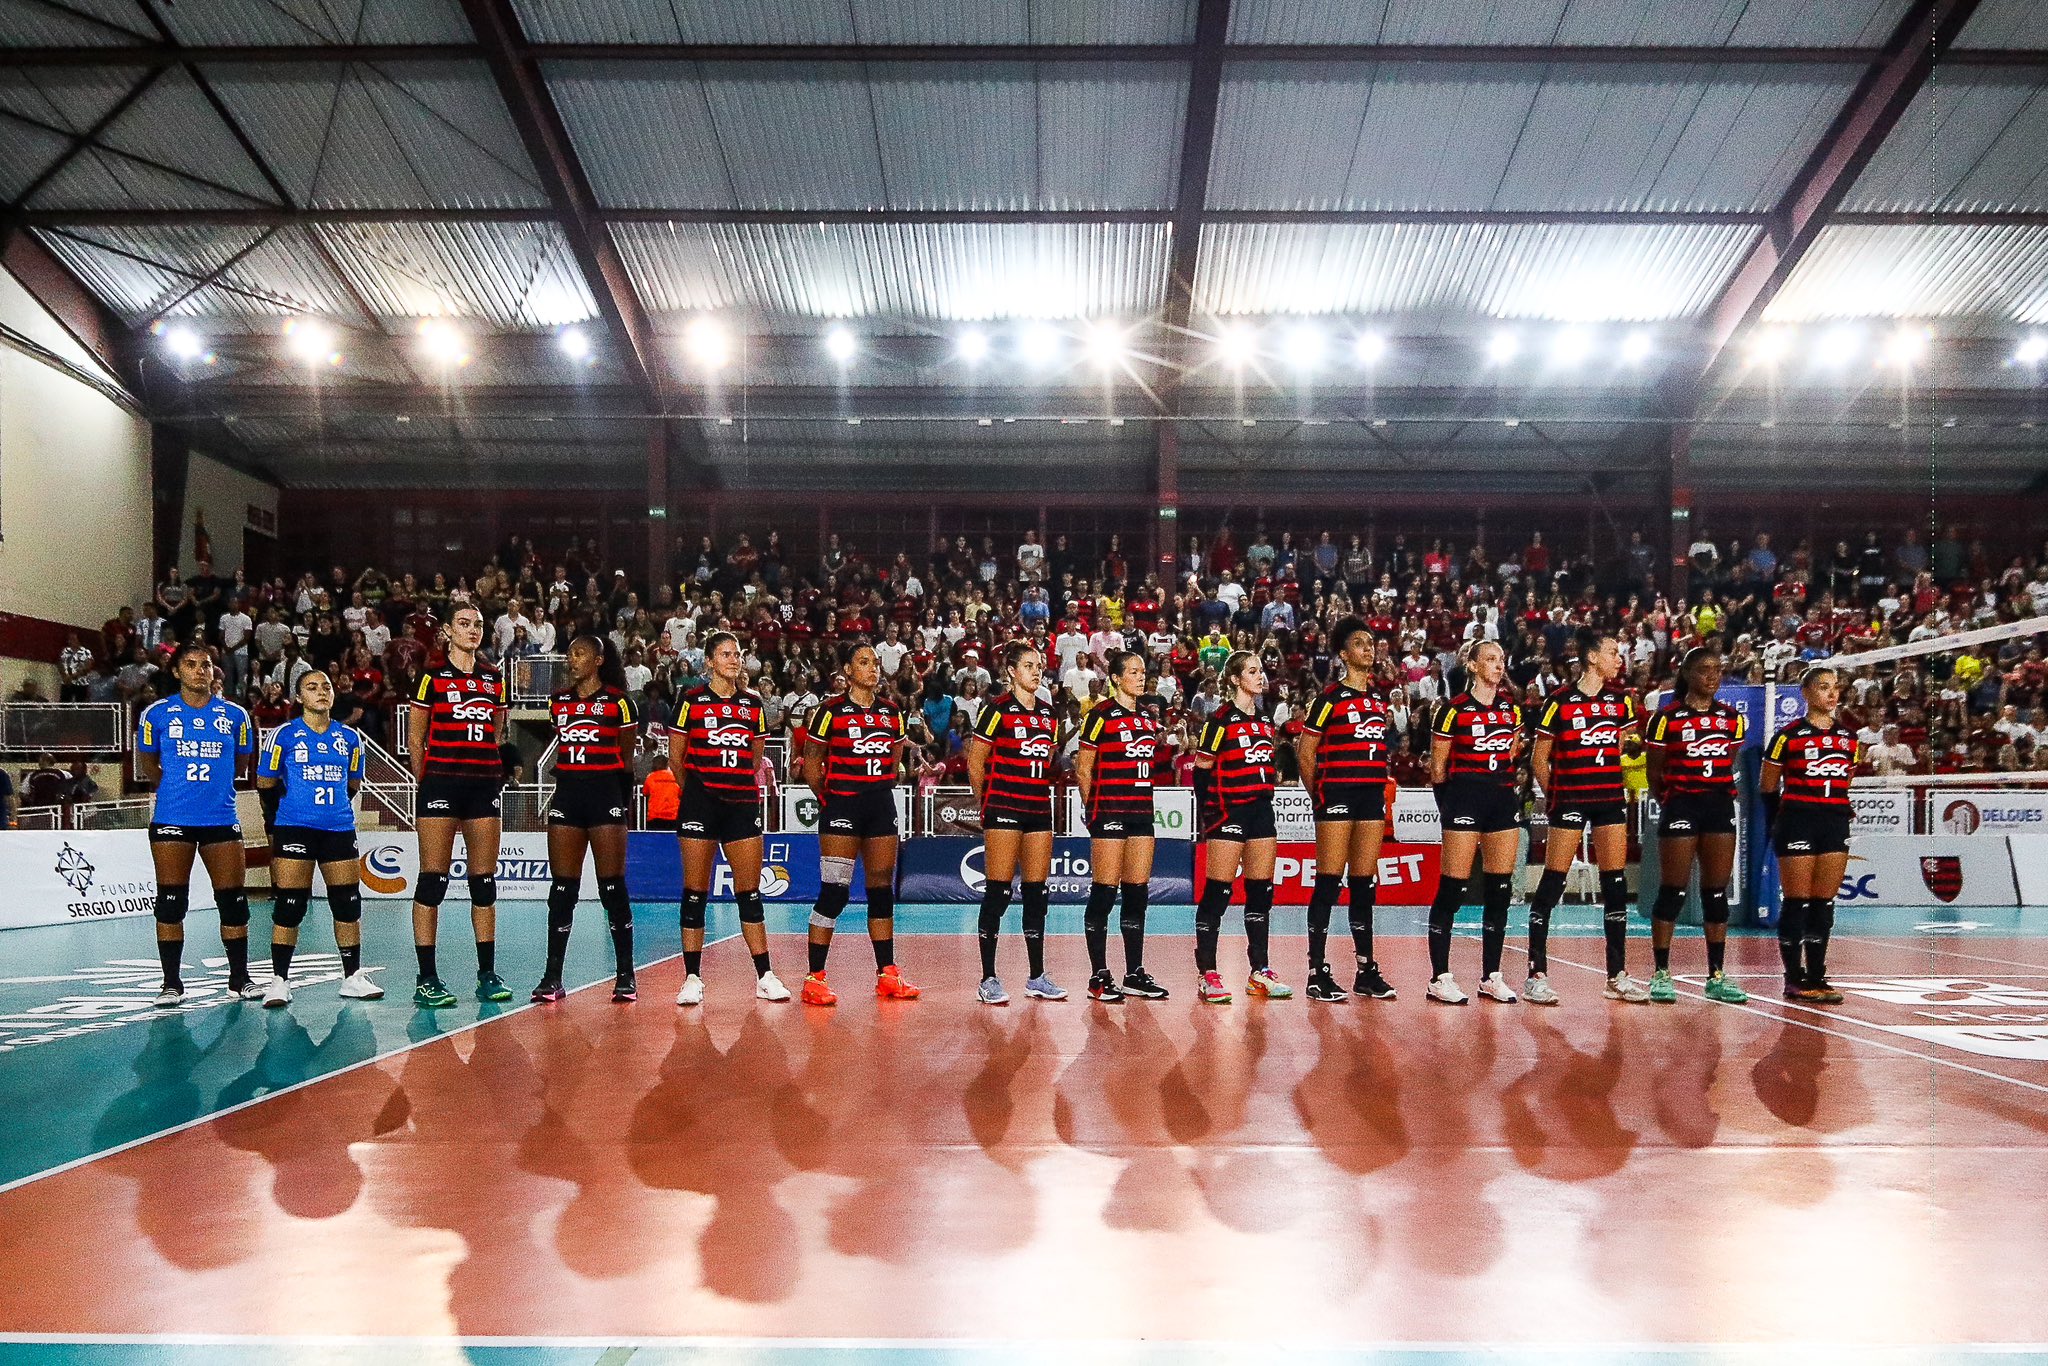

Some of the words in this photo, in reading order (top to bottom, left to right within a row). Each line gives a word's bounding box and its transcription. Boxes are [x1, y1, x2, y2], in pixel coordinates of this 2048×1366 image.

[467, 723, 484, 742] 15
[568, 746, 586, 764] 14
[720, 749, 738, 768] 13
[1369, 743, 1377, 761] 7
[1595, 748, 1605, 766] 4
[865, 758, 882, 776] 12
[1030, 760, 1043, 779] 11
[1136, 761, 1150, 779] 10
[1488, 753, 1498, 771] 6
[1702, 759, 1714, 777] 3
[186, 763, 210, 781] 22
[314, 786, 334, 805] 21
[1822, 780, 1832, 797] 1
[1271, 797, 1311, 811] spaç
[1850, 799, 1895, 812] spaço
[1276, 810, 1314, 822] harm
[1398, 813, 1439, 823] ARCOV
[100, 881, 154, 896] FUNDAÇ
[67, 900, 116, 918] SERGIO
